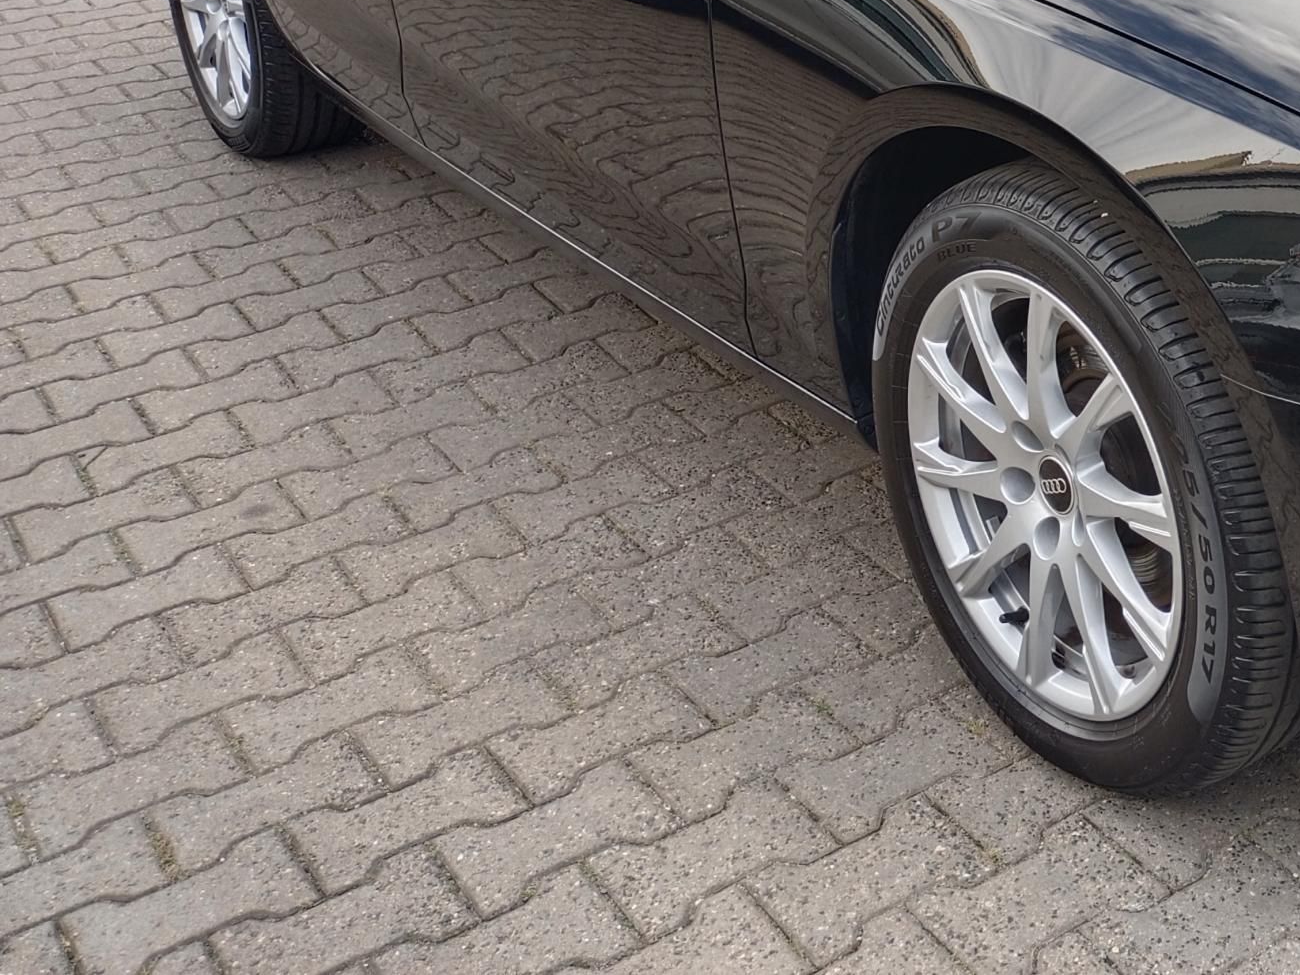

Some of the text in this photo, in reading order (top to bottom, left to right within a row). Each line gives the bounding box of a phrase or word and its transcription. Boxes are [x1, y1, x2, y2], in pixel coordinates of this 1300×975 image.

[876, 211, 983, 337] Cinturato P7
[937, 242, 977, 262] BLUE
